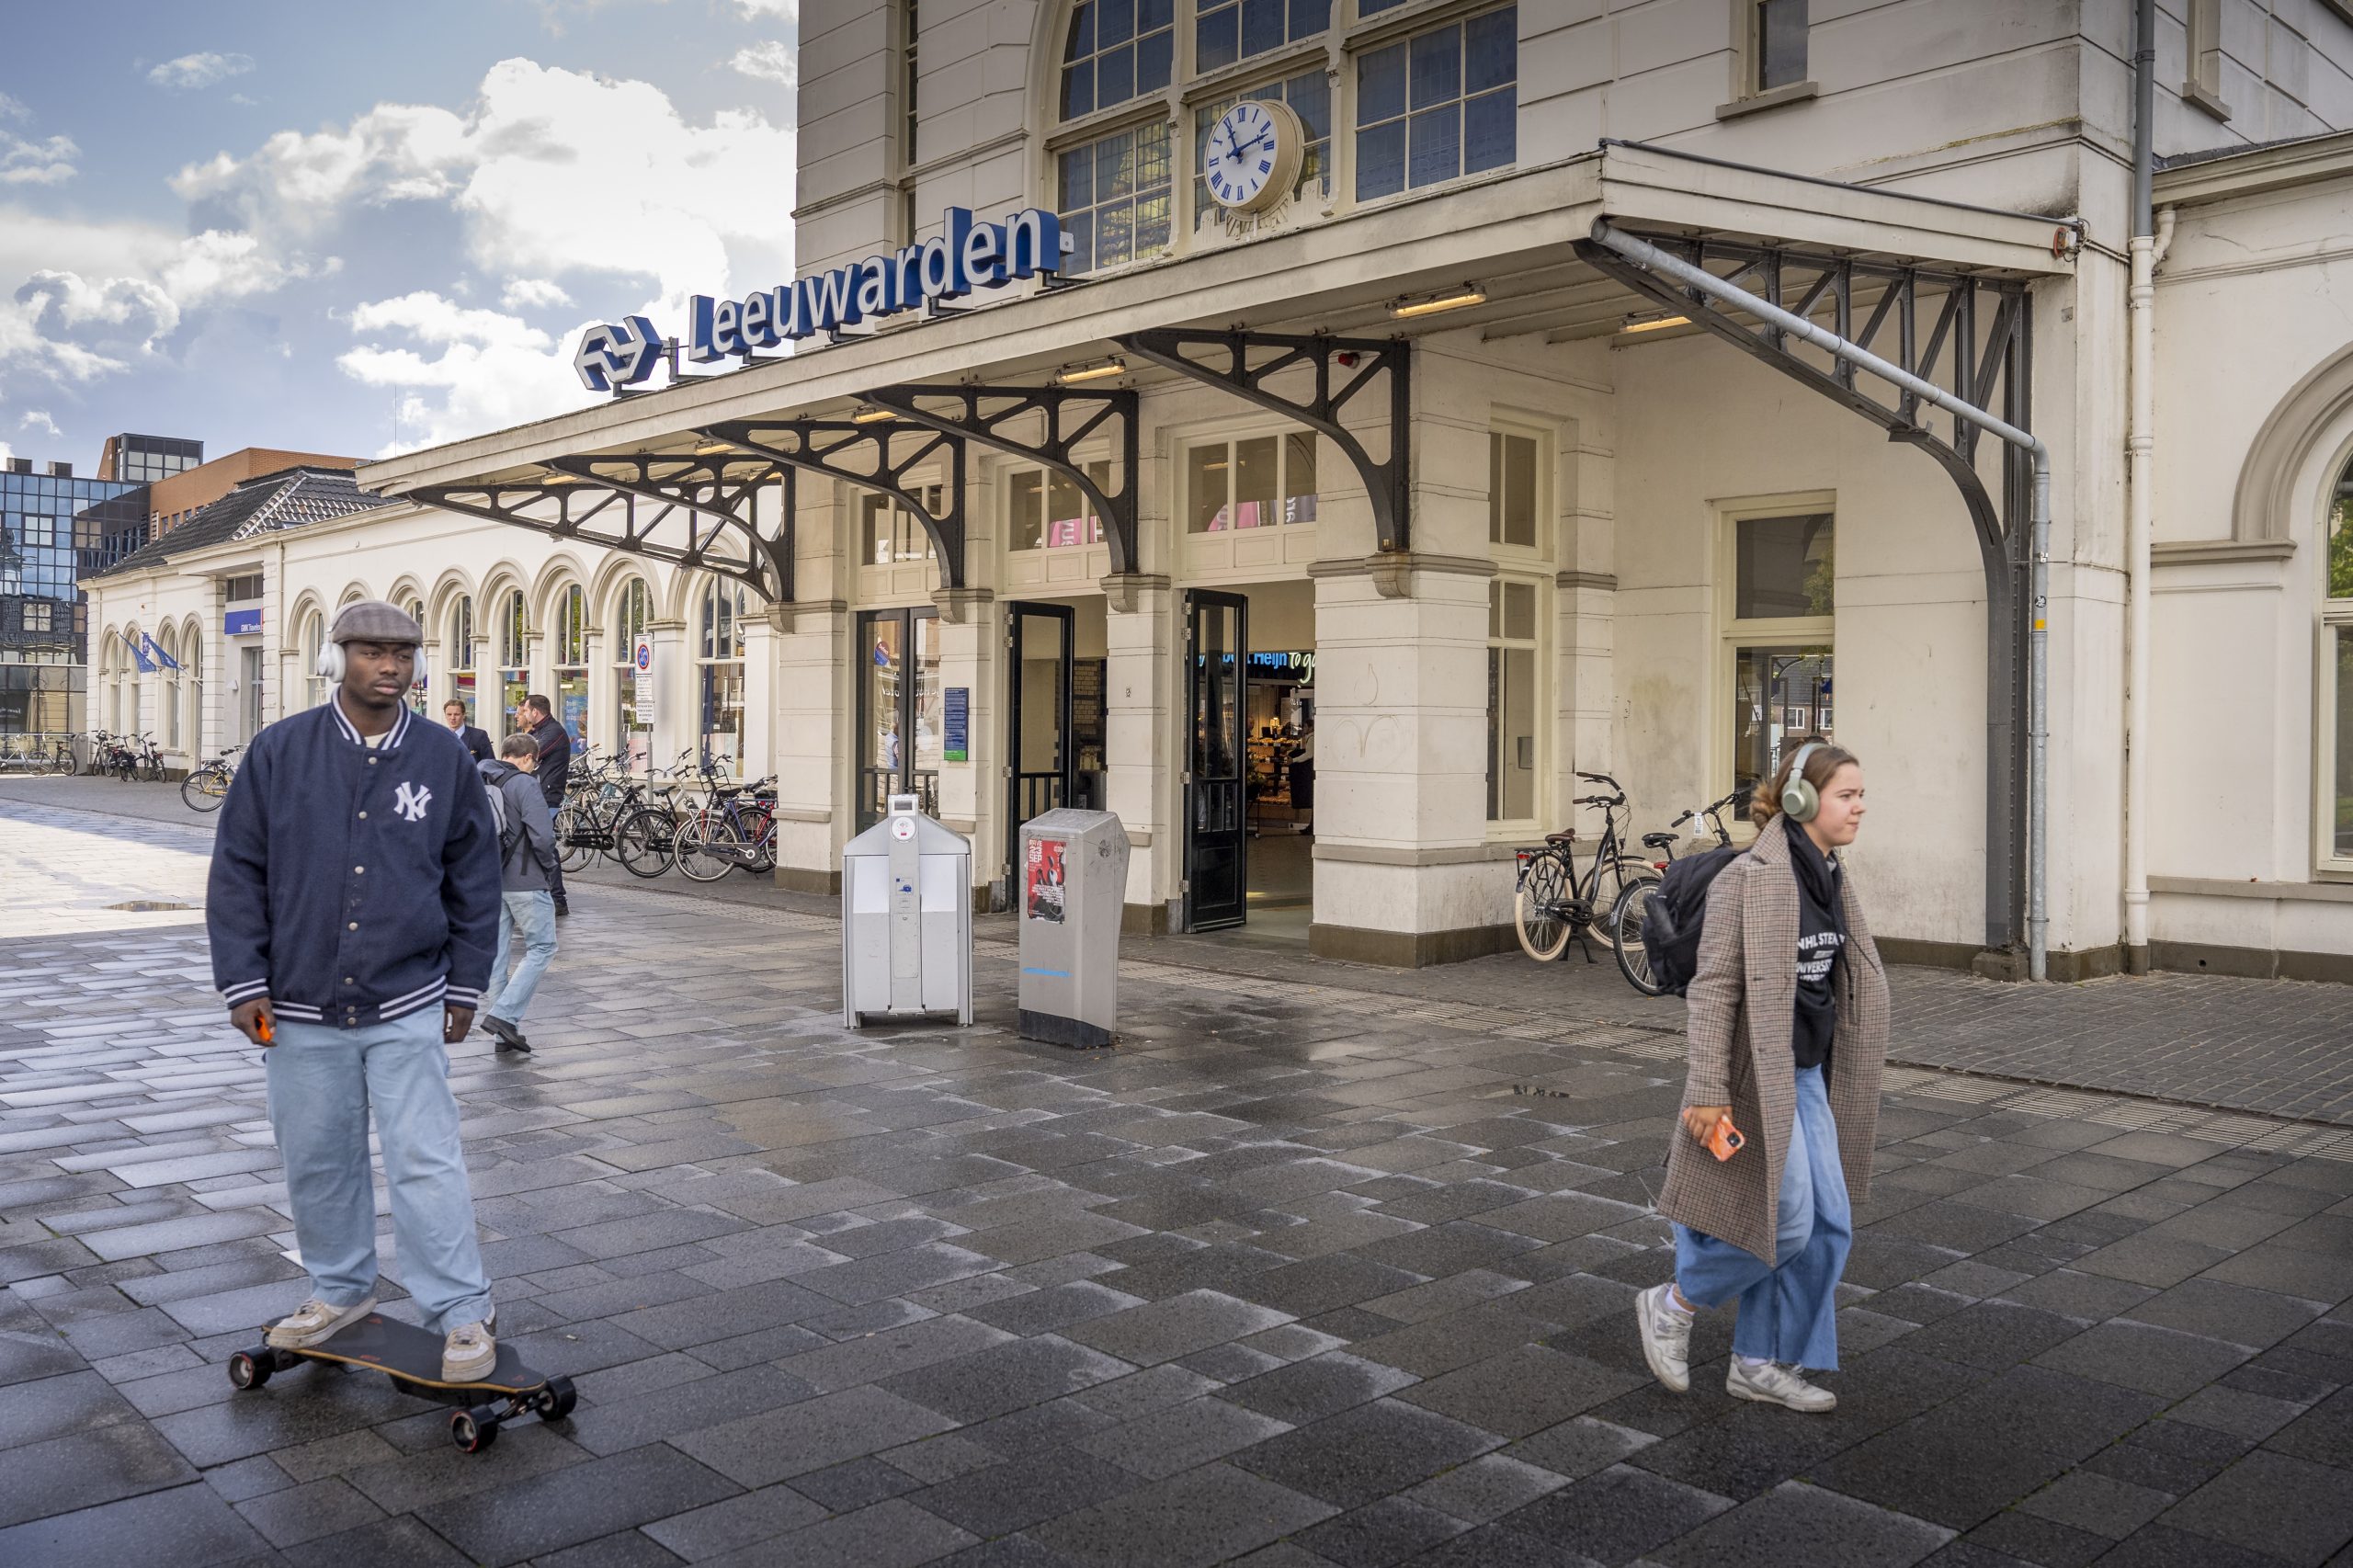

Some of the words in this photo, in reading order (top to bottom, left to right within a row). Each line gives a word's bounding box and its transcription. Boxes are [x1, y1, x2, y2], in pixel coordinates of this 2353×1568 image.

[688, 206, 1060, 363] Leeuwarden
[1254, 653, 1288, 669] Heijn
[393, 781, 433, 822] NY
[1029, 846, 1043, 855] 23
[1029, 854, 1043, 863] SEP
[1796, 959, 1834, 973] NIVERSIT
